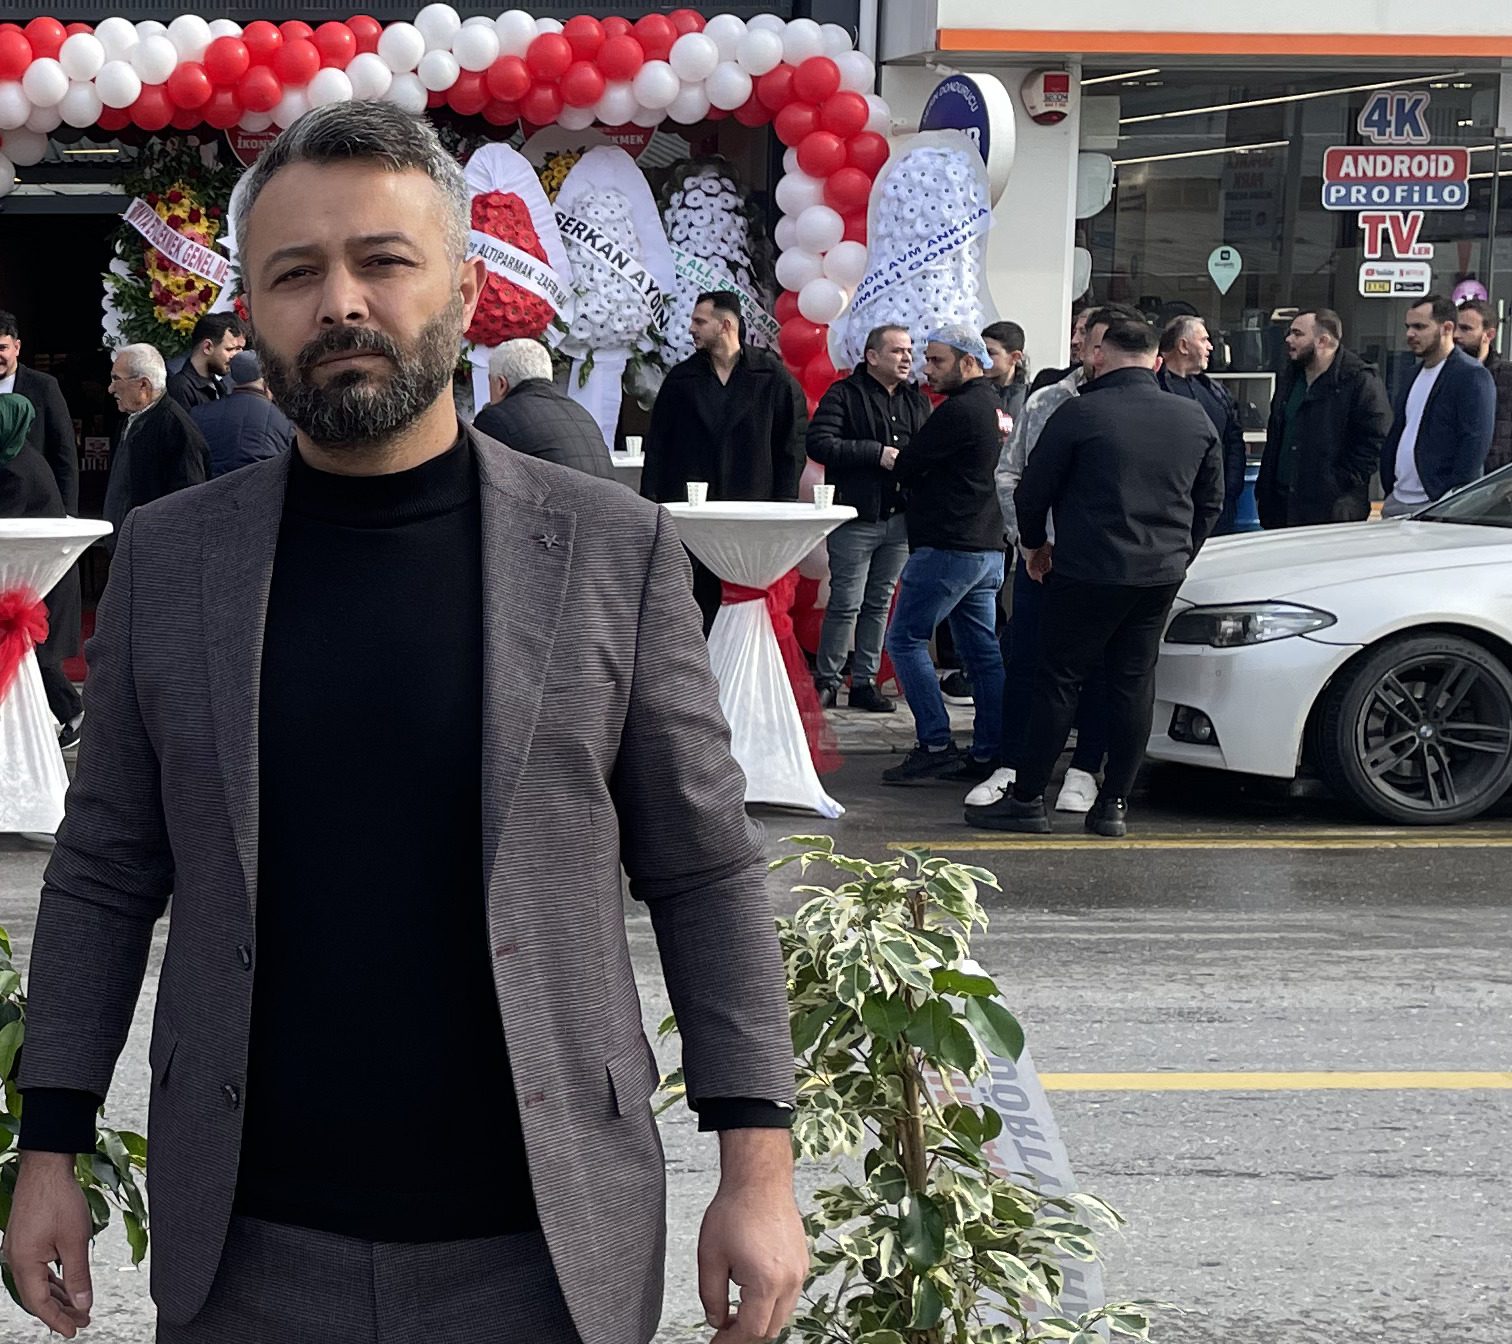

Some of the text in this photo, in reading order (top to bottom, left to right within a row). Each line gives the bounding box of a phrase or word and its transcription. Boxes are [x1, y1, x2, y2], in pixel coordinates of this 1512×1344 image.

[1363, 96, 1428, 139] 4K
[181, 244, 215, 278] GENEL
[889, 246, 922, 271] AVM
[927, 208, 988, 248] ANKARA
[478, 243, 535, 280] ALTIPARMAK
[554, 211, 670, 330] SERKAN AYDIN
